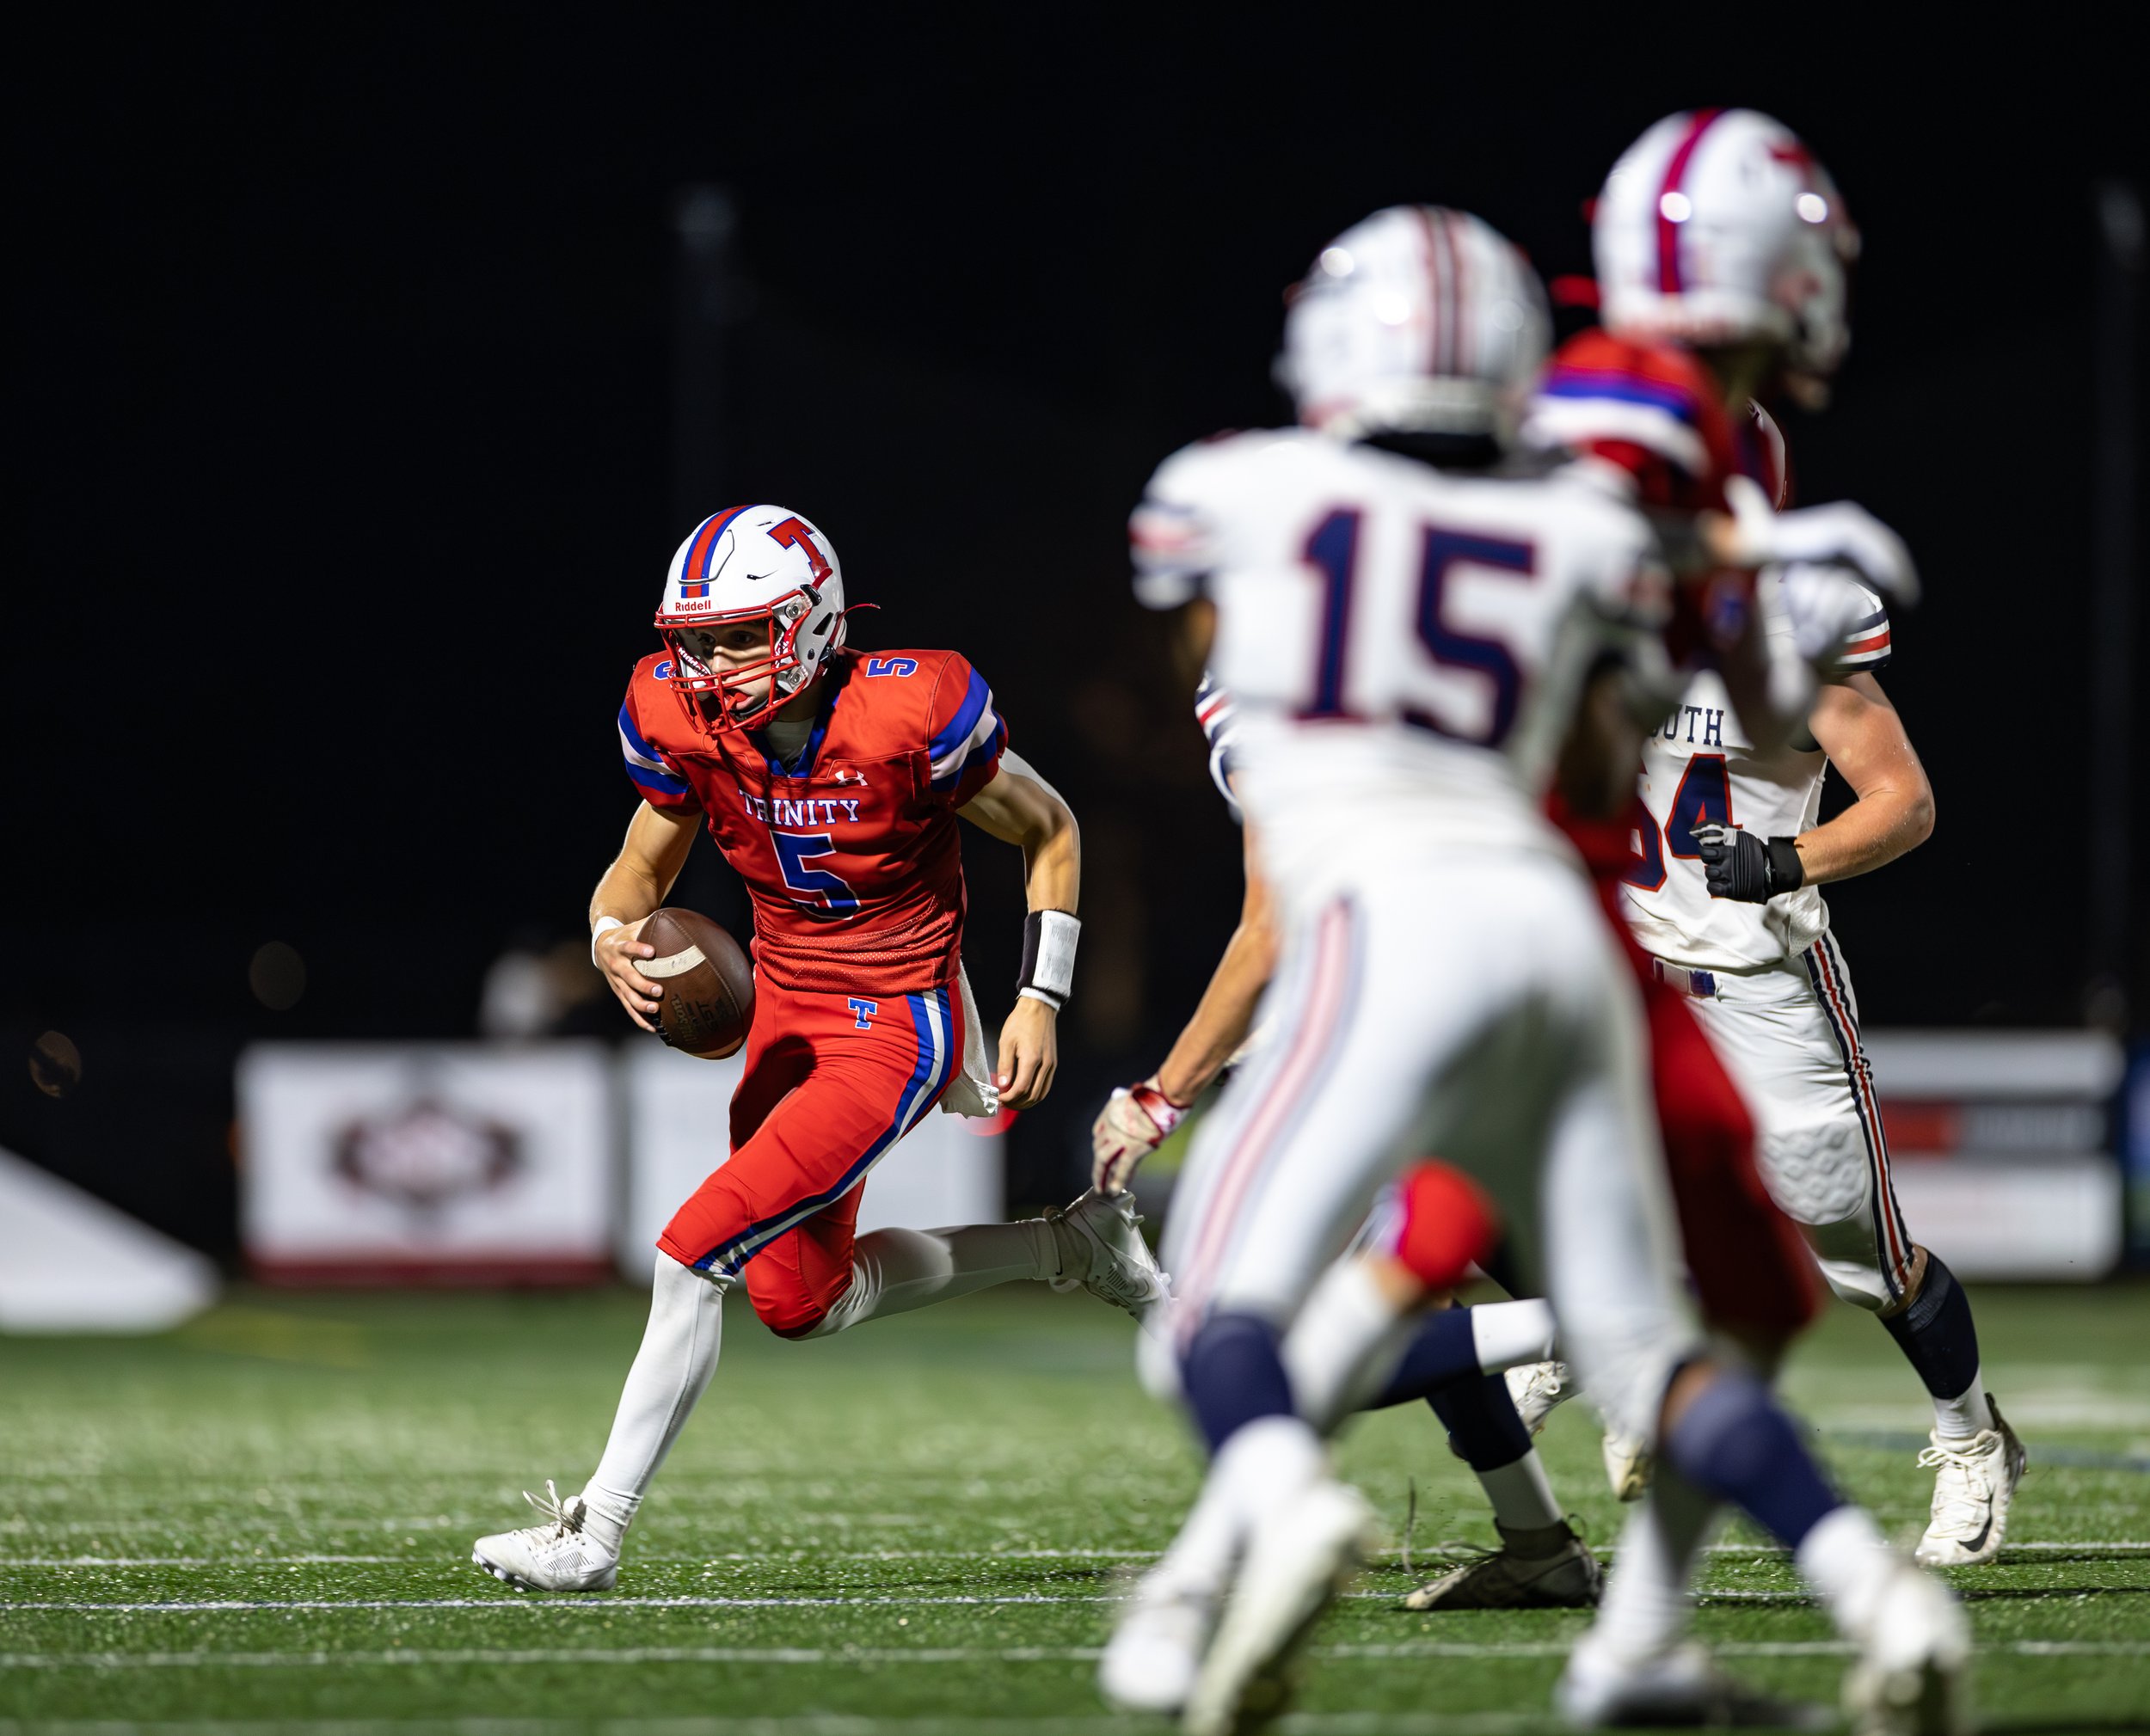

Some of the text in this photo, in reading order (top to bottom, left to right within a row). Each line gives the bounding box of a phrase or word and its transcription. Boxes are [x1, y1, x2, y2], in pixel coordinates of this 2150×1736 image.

[765, 516, 830, 580] T
[675, 599, 711, 612] Riddell
[1292, 506, 1539, 750] 15
[865, 657, 919, 678] 5
[1650, 704, 1724, 747] UTH
[738, 788, 859, 827] TRINITY
[769, 830, 862, 920] 5
[848, 997, 878, 1030] T
